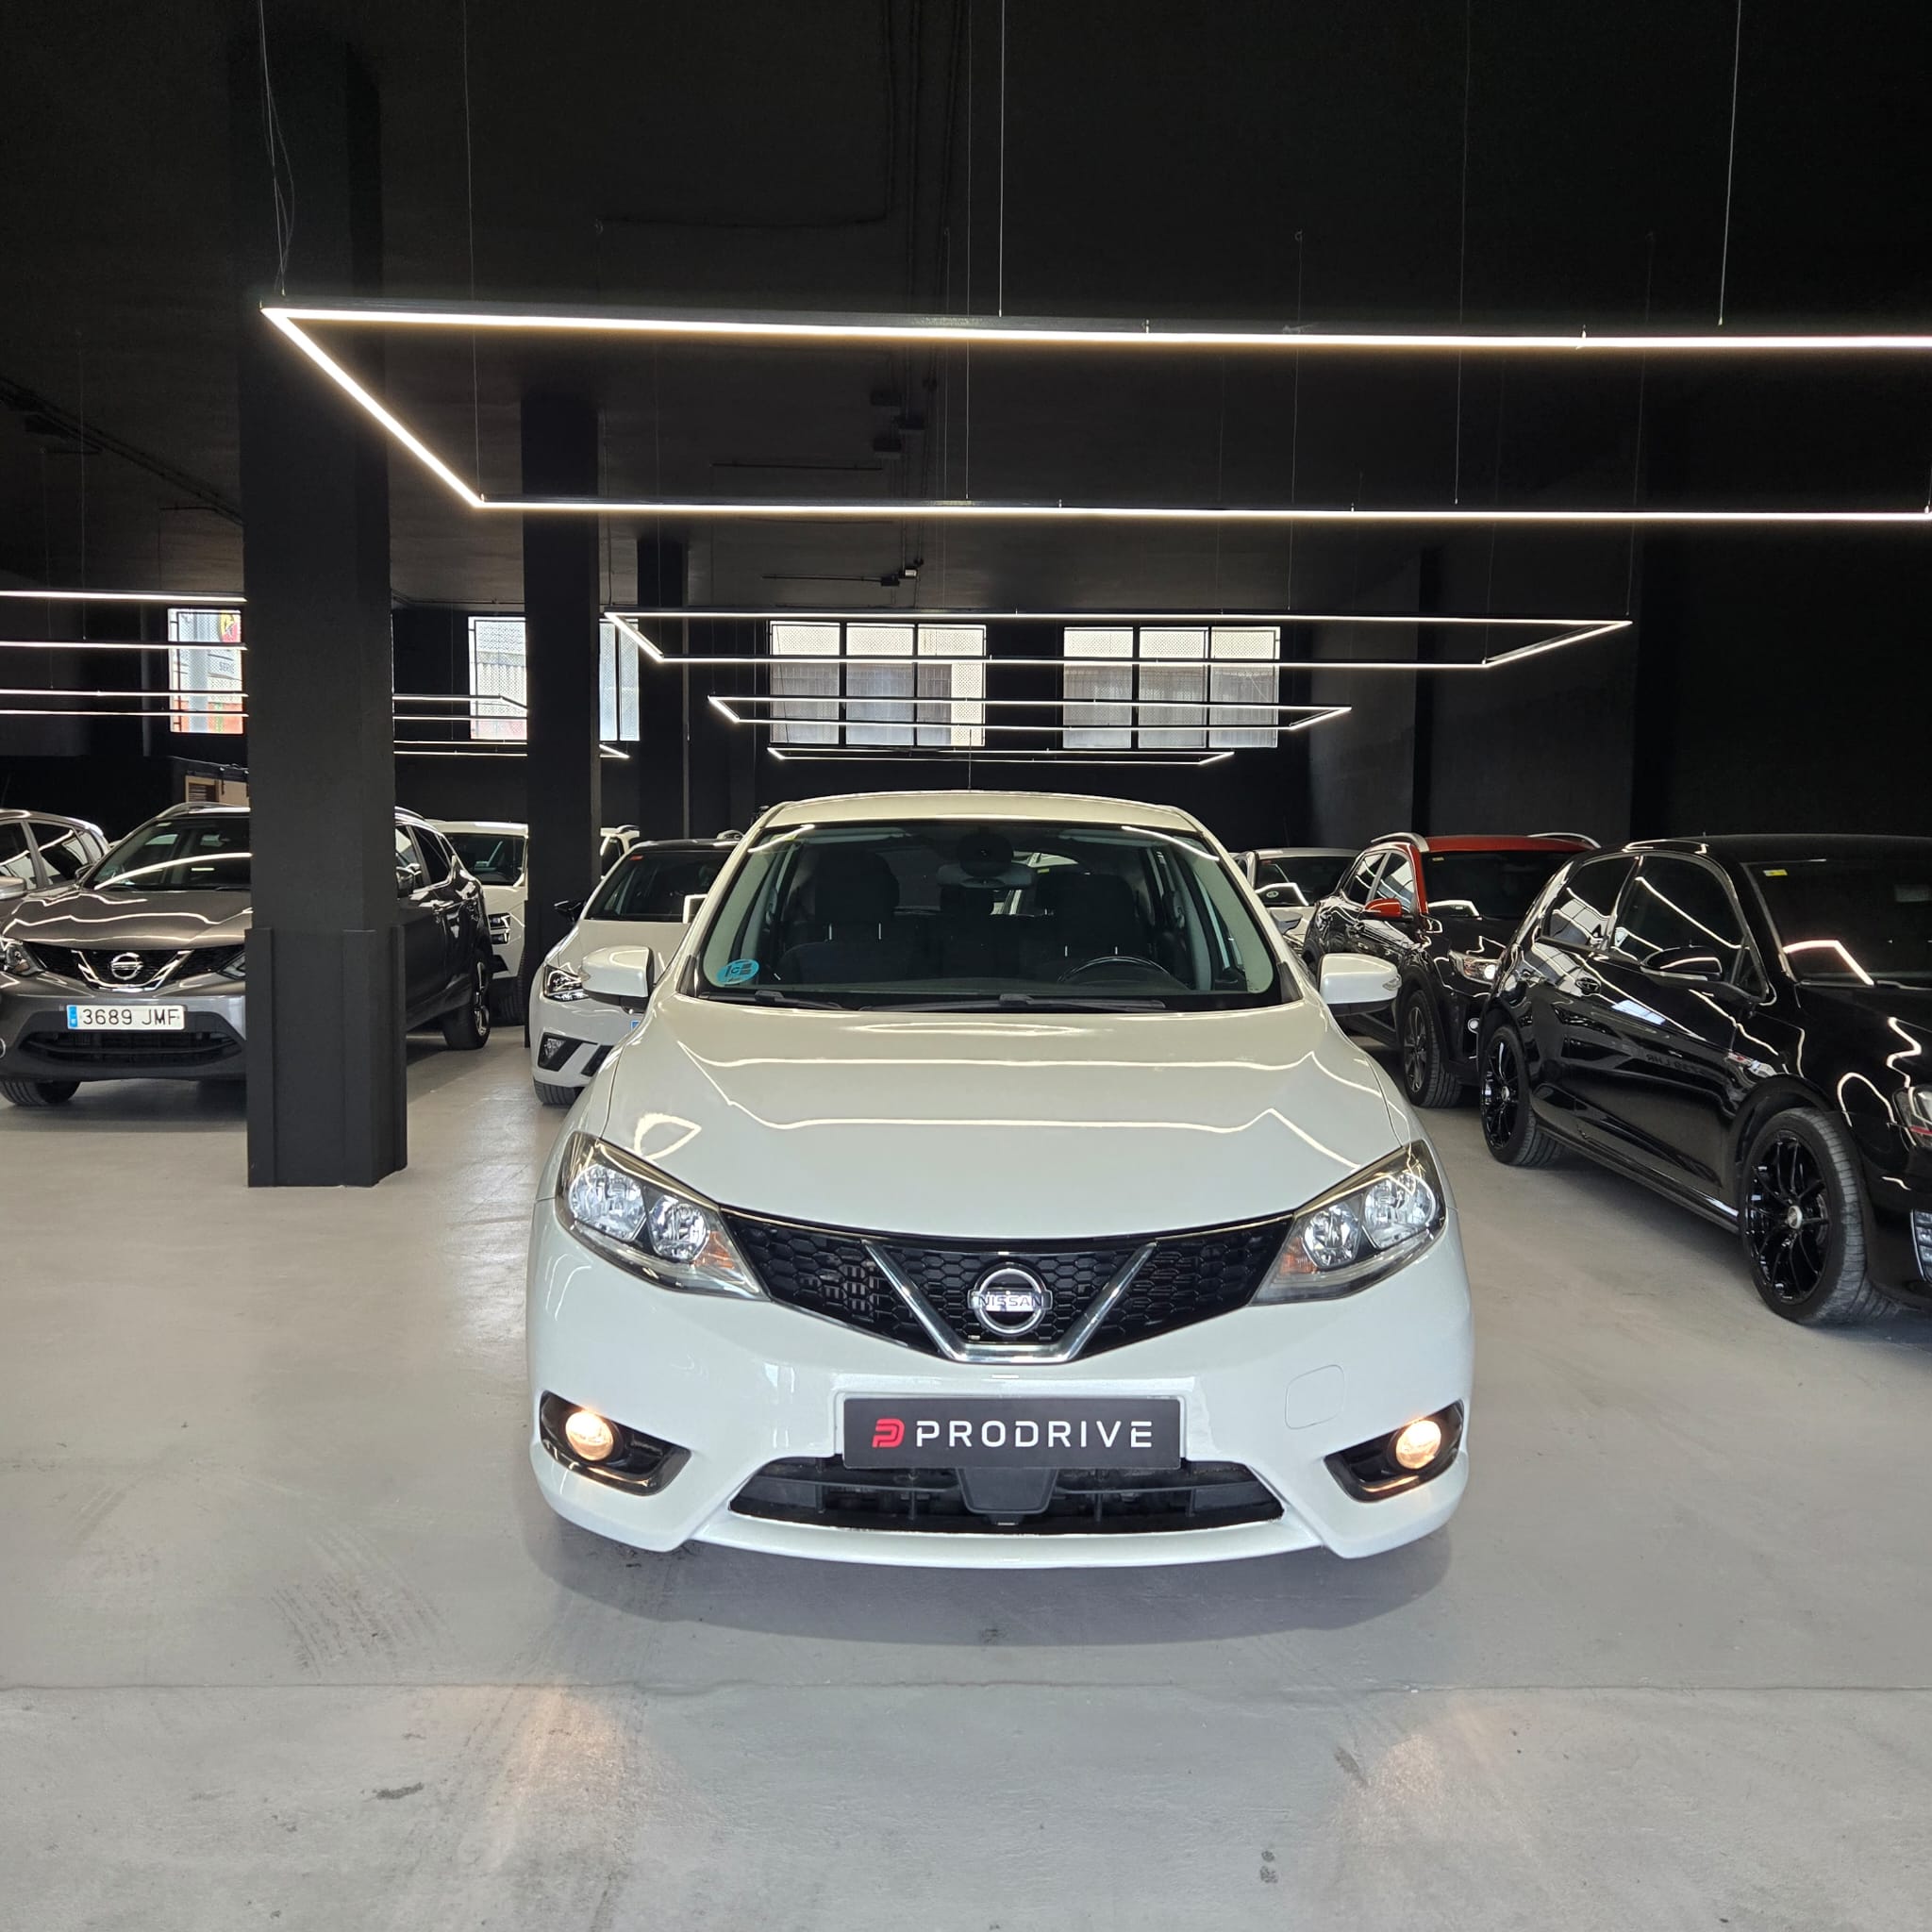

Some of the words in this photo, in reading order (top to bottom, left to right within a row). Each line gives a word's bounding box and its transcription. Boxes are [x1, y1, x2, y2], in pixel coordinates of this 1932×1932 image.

[82, 1008, 132, 1025] 3689
[142, 1008, 179, 1025] JMF
[978, 1293, 1042, 1307] NISSAN
[916, 1420, 1153, 1448] PRODRIVE
